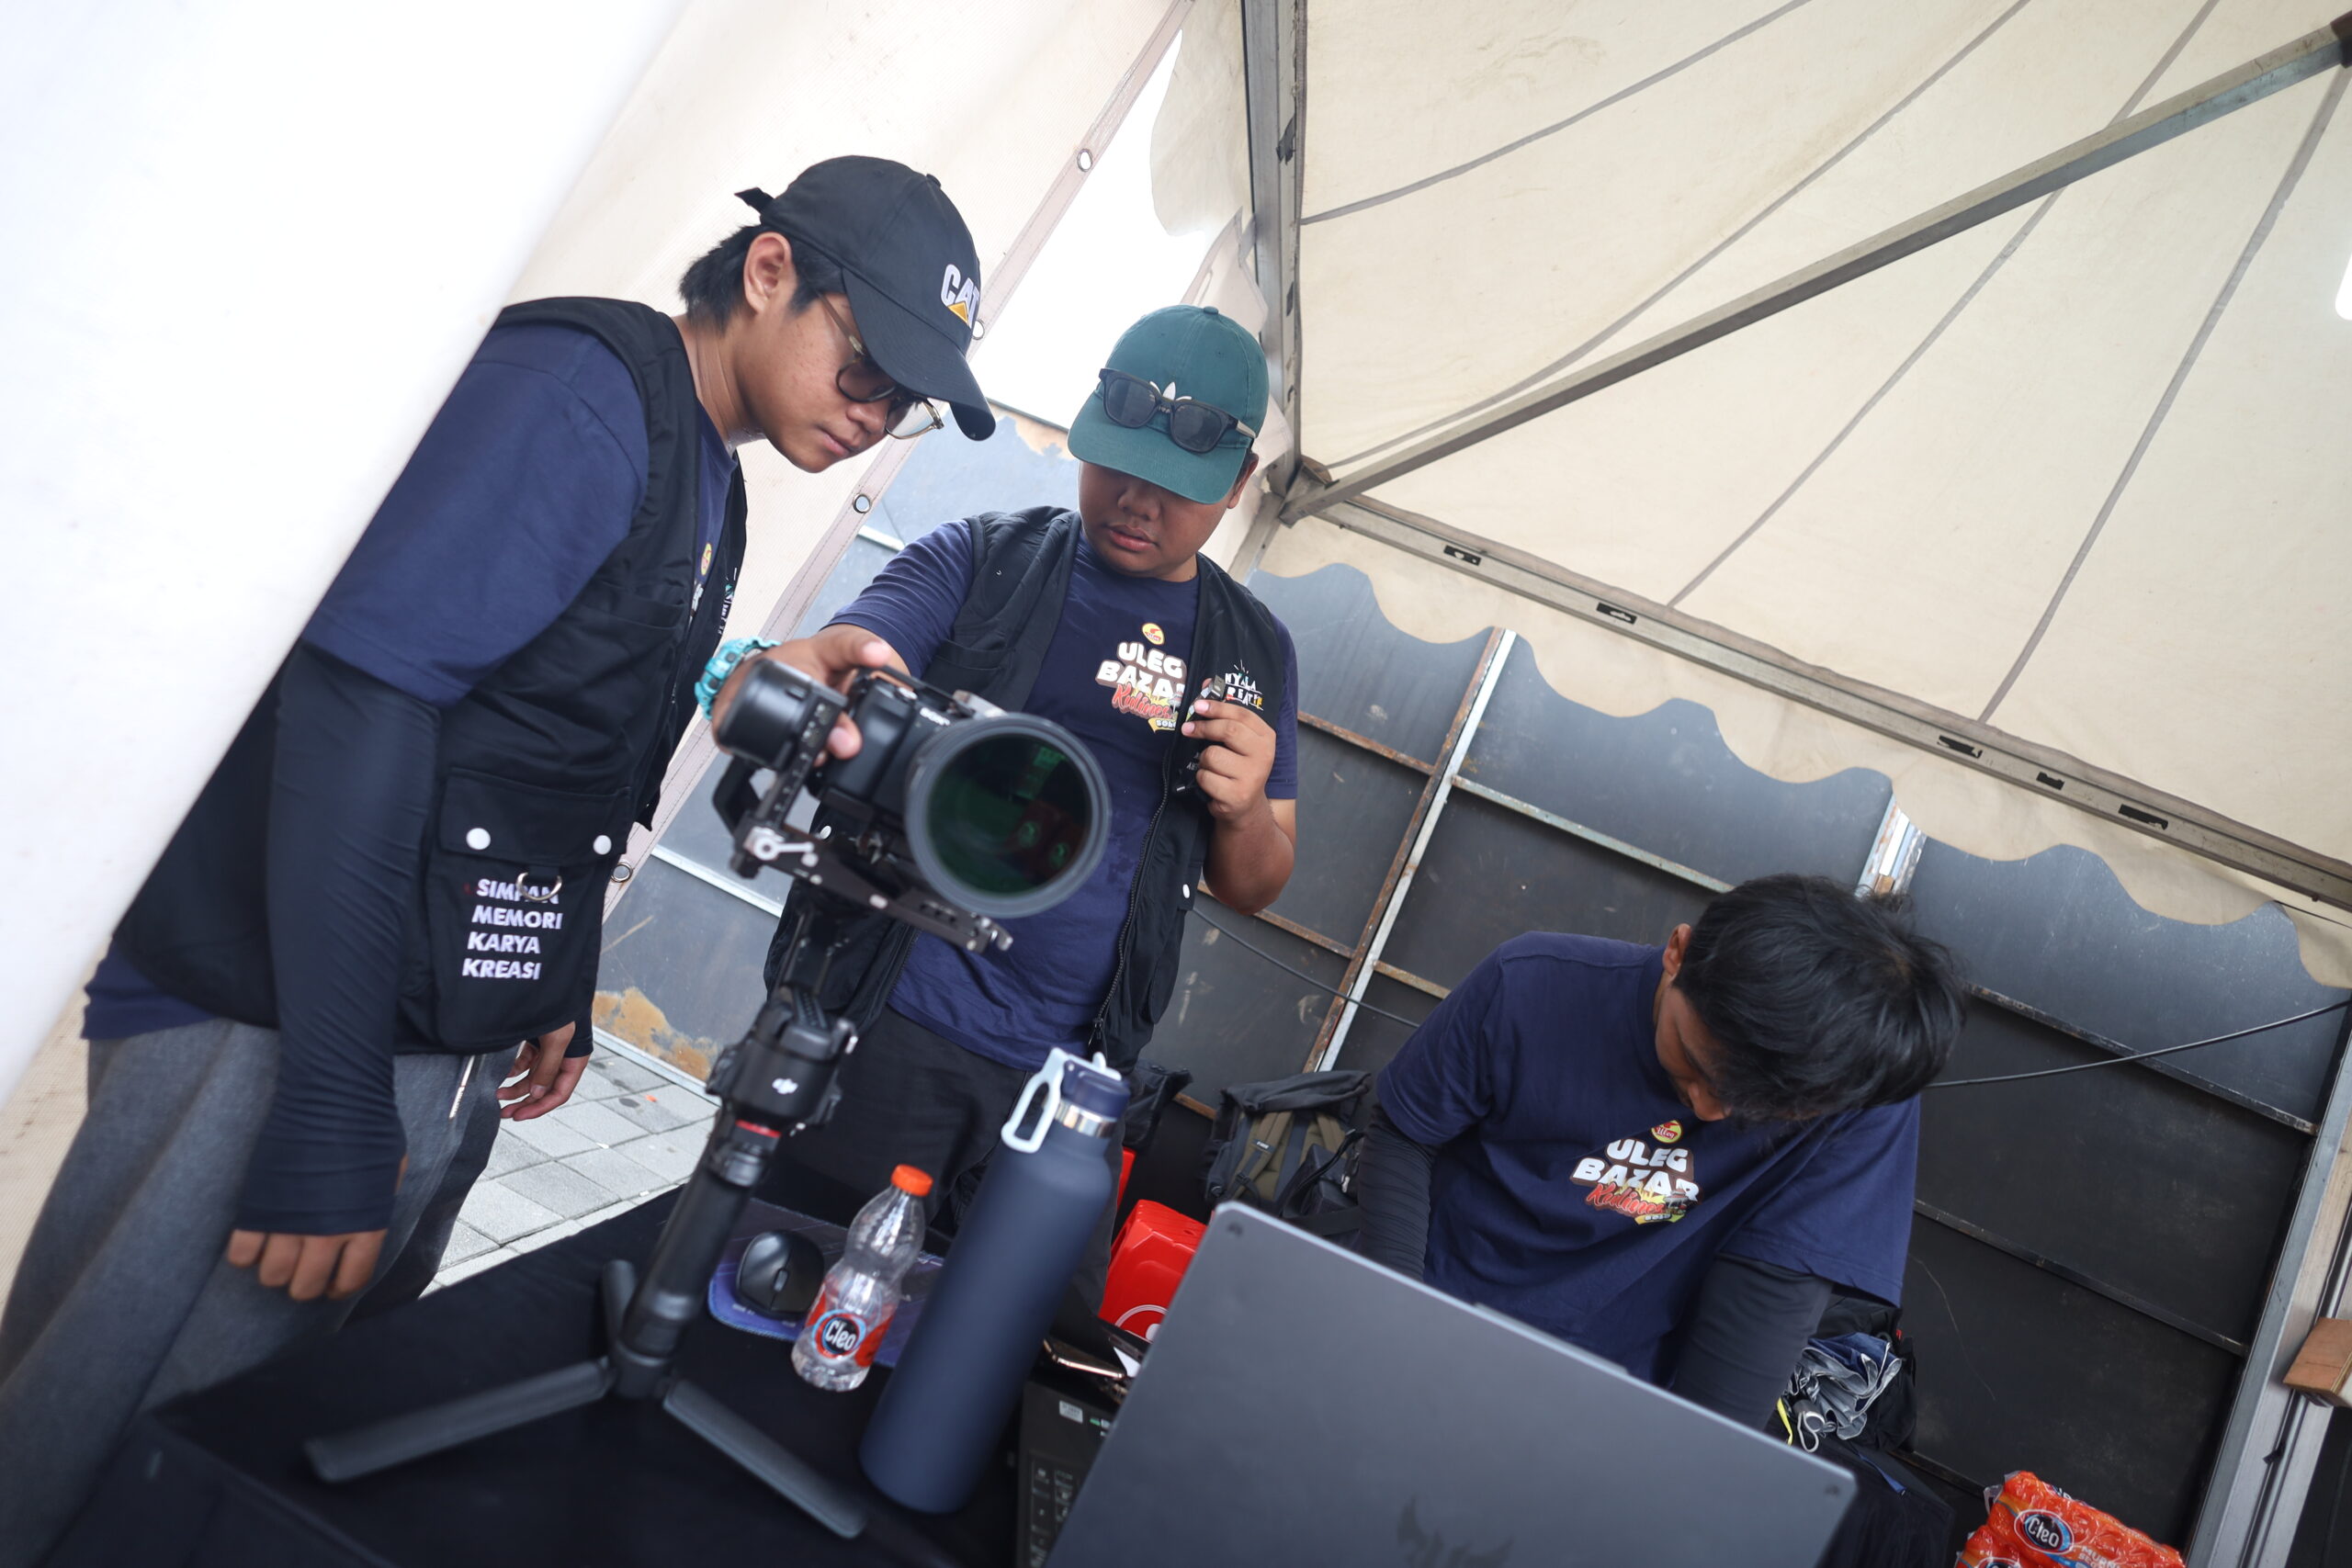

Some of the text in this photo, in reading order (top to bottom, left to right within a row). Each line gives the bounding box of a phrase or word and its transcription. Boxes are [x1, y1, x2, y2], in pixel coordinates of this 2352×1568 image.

[1118, 642, 1184, 680] ULEG
[471, 905, 563, 930] MEMORI
[467, 931, 540, 954] KARYA
[461, 958, 542, 980] KREASI
[1606, 1139, 1689, 1172] ULEG
[1572, 1157, 1700, 1201] BAZAR
[825, 1320, 857, 1351] Cleo
[2028, 1517, 2060, 1548] Cleo
